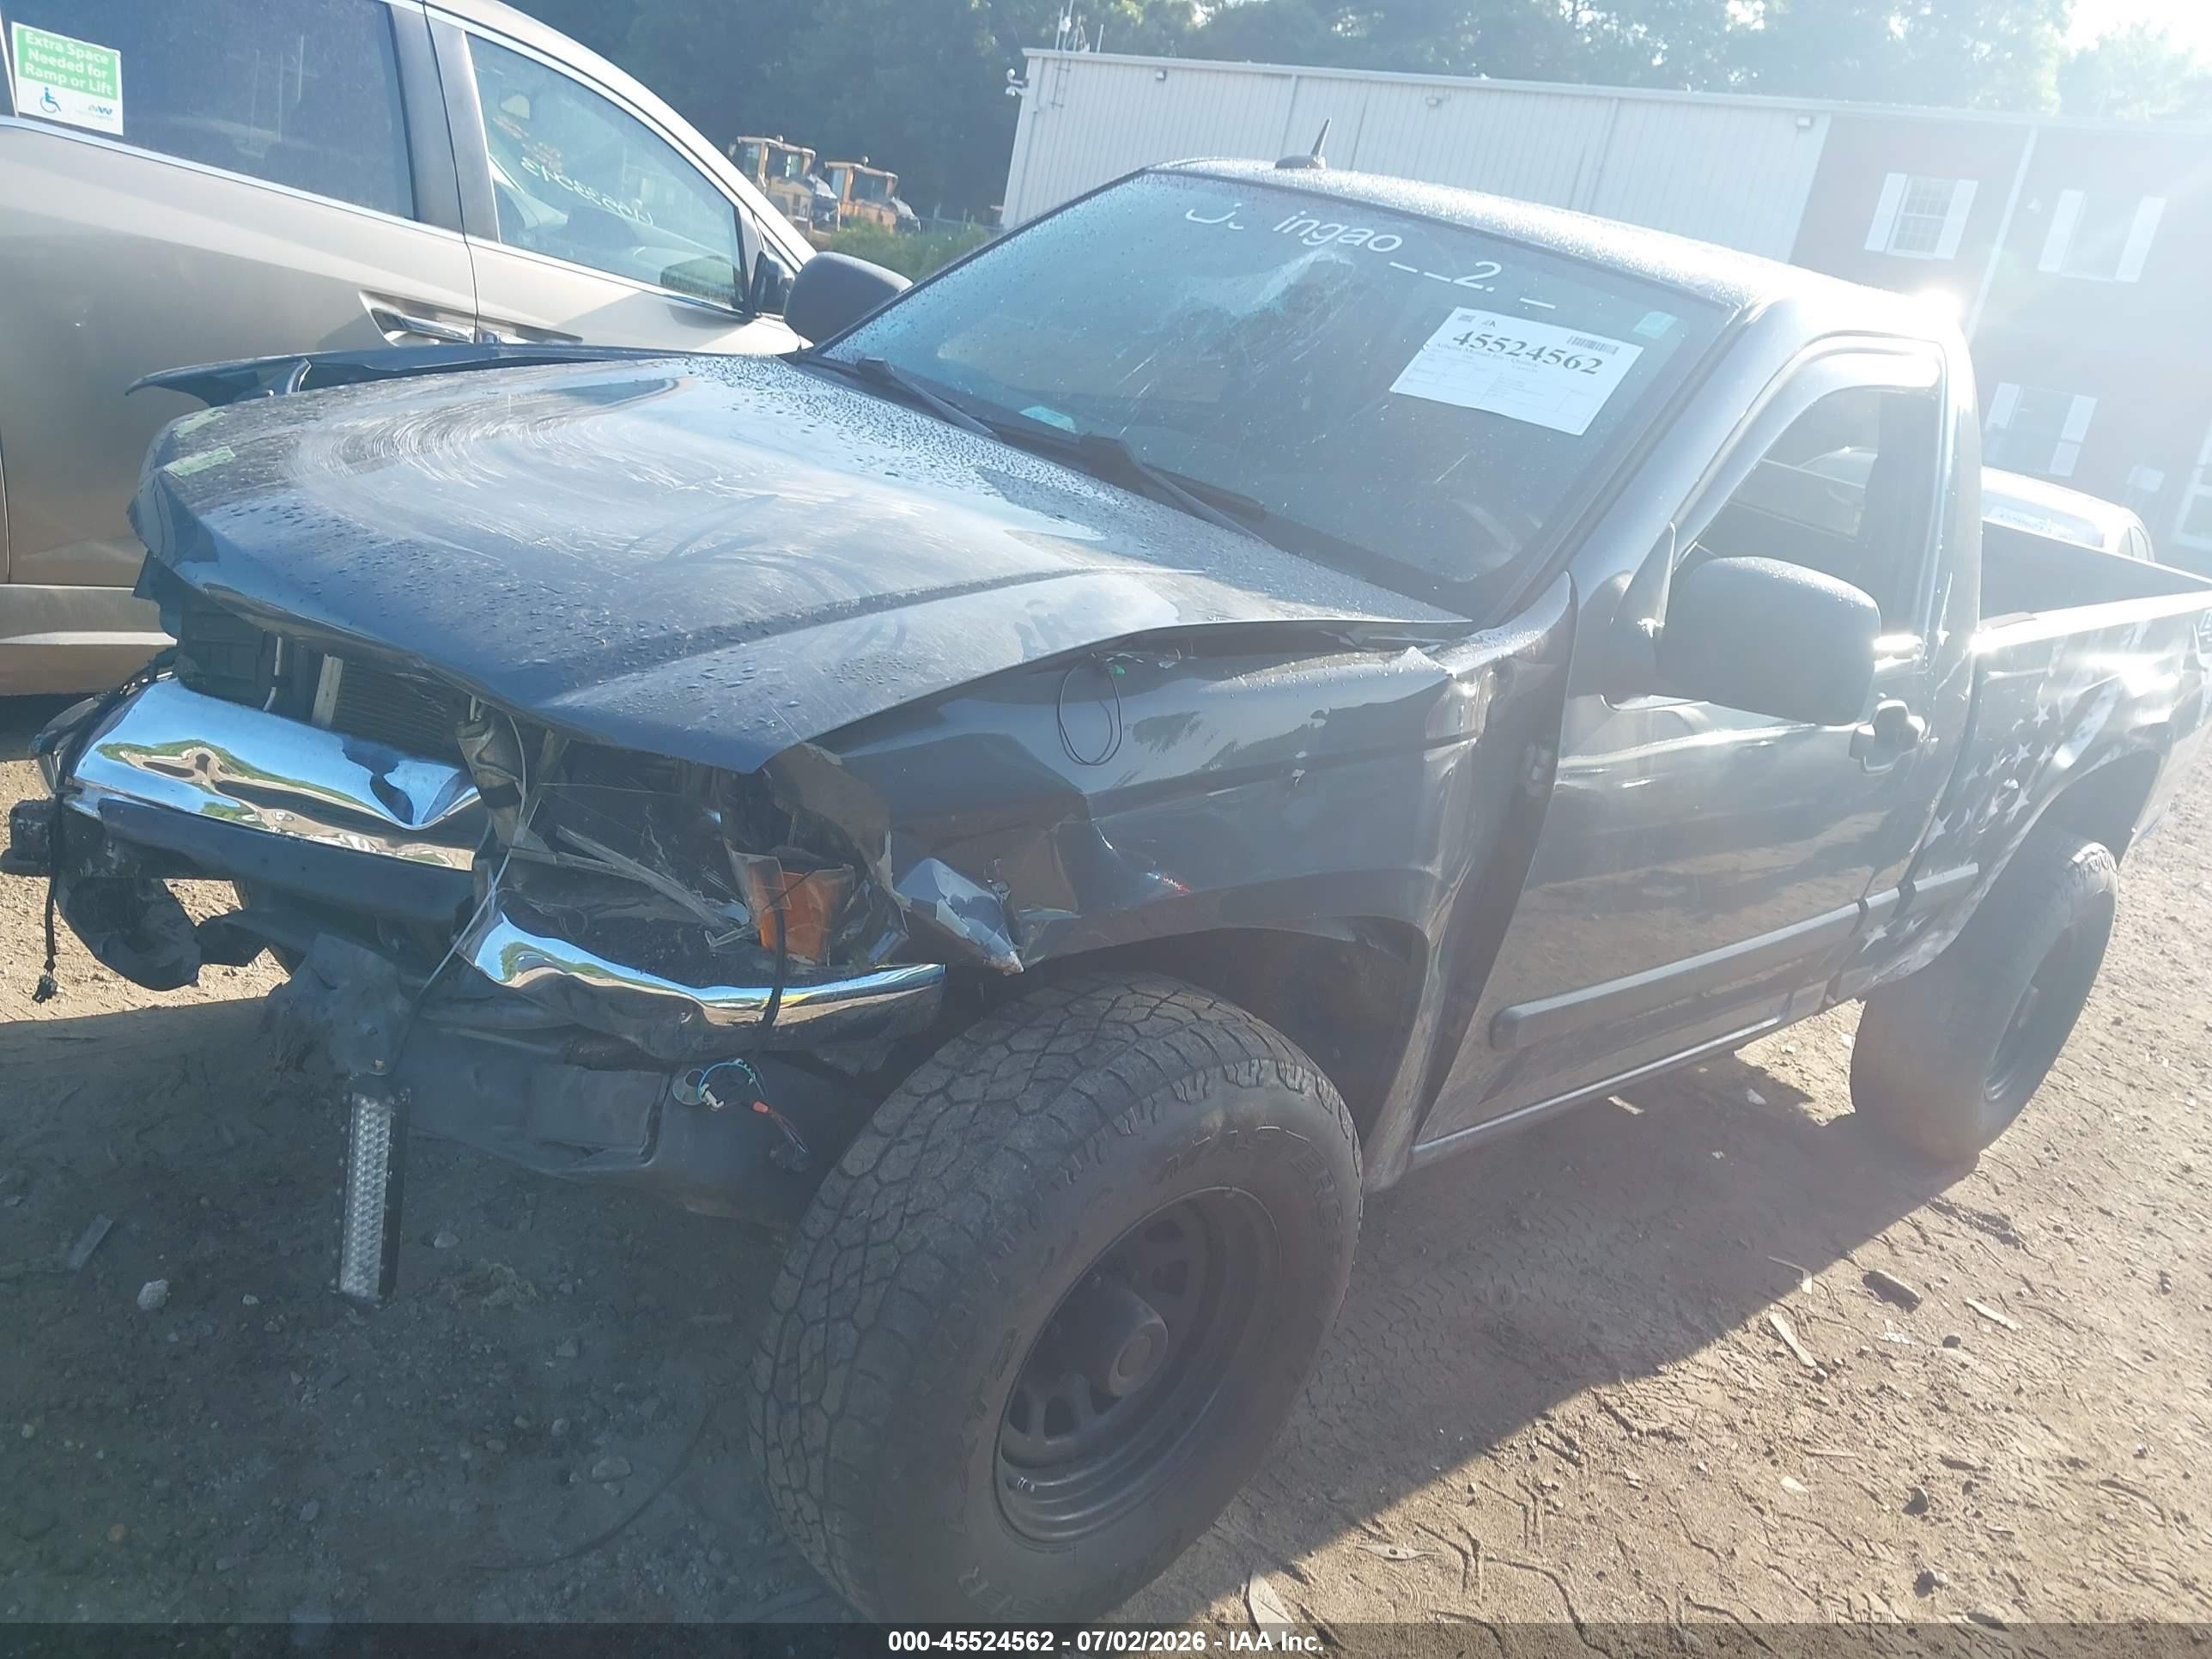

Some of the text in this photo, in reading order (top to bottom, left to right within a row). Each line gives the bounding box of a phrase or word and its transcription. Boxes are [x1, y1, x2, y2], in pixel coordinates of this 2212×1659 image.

[25, 31, 109, 64] Extra Space
[27, 49, 107, 79] Needed for
[25, 62, 112, 95] Ramp or Lift
[1452, 330, 1603, 375] 45524562
